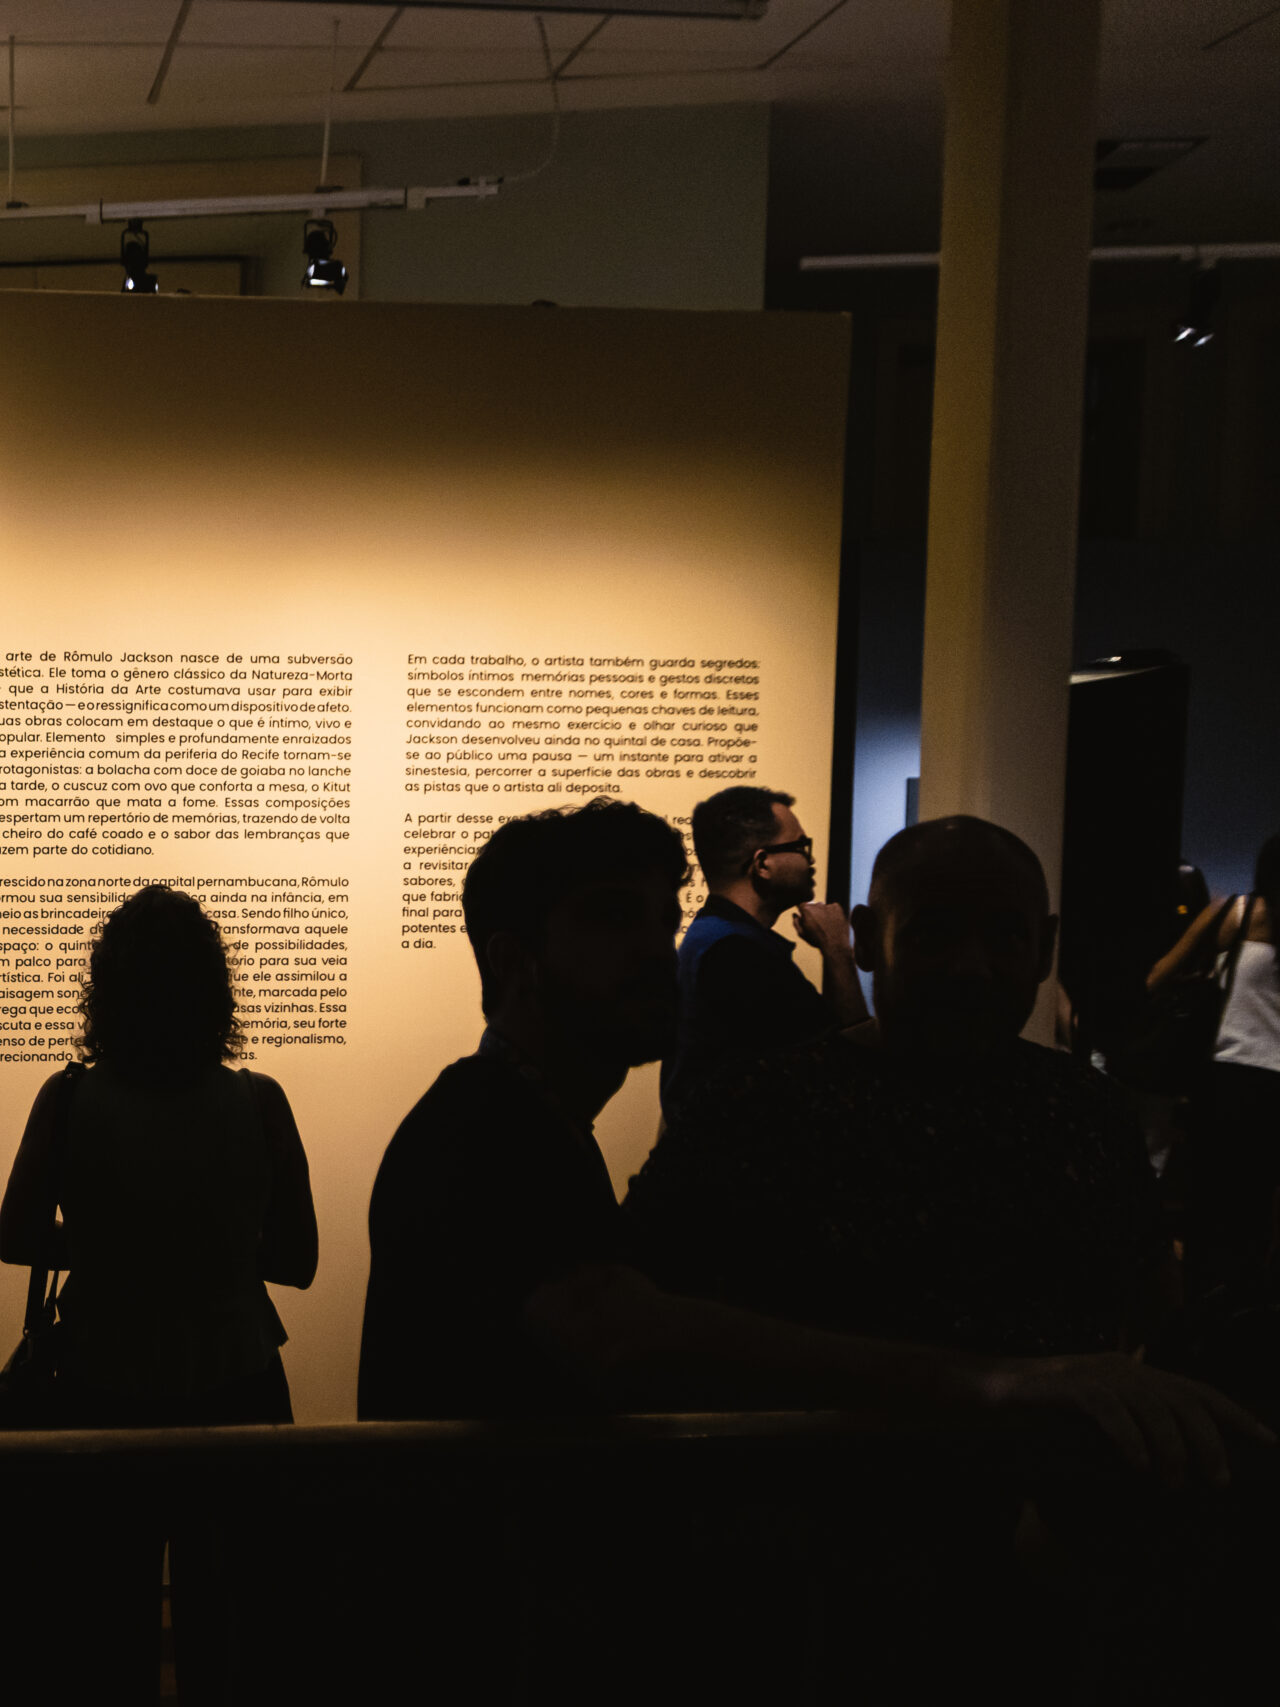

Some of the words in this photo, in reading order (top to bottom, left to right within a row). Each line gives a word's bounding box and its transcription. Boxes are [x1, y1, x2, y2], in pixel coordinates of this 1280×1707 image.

[5, 650, 32, 661] arte
[39, 650, 56, 662] de
[63, 650, 112, 662] Rômulo
[120, 651, 173, 663] Jackson
[180, 654, 219, 663] nasce
[226, 652, 243, 663] de
[250, 655, 279, 664] uma
[287, 653, 353, 665] subversão
[49, 666, 66, 678] Ele
[71, 667, 106, 678] toma
[110, 669, 119, 678] o
[123, 667, 169, 682] gênero
[173, 667, 225, 679] clássico
[229, 668, 246, 679] da
[251, 669, 352, 680] Natureza-Morta
[407, 668, 464, 680] símbolos
[468, 670, 514, 681] íntimos
[521, 671, 585, 682] memórias
[589, 673, 644, 685] pessoais
[647, 674, 655, 683] e
[659, 673, 700, 687] gestos
[703, 673, 759, 685] discretos
[406, 687, 431, 699] que
[437, 688, 451, 696] se
[457, 687, 524, 697] escondem
[530, 688, 562, 698] entre
[568, 689, 613, 700] nomes,
[620, 690, 654, 699] cores
[659, 690, 668, 699] e
[673, 688, 720, 700] formas.
[725, 689, 759, 701] Esses
[24, 715, 62, 726] obras
[65, 715, 123, 727] colocam
[127, 718, 148, 727] em
[152, 716, 213, 730] destaque
[216, 719, 225, 727] o
[228, 719, 253, 731] que
[257, 717, 265, 728] é
[269, 716, 311, 730] íntimo,
[315, 720, 340, 728] vivo
[344, 720, 351, 728] e
[45, 731, 105, 743] Elemento
[115, 731, 165, 746] simples
[168, 734, 176, 743] e
[179, 732, 279, 746] profundamente
[282, 733, 351, 744] enraizados
[406, 733, 457, 744] Jackson
[461, 733, 540, 745] desenvolveu
[544, 735, 580, 745] ainda
[584, 737, 600, 745] no
[603, 736, 647, 749] quintal
[650, 736, 666, 746] de
[670, 737, 704, 747] casa.
[707, 736, 756, 750] Propõe-
[10, 747, 84, 761] experiência
[88, 750, 139, 759] comum
[143, 748, 160, 759] da
[165, 748, 217, 762] periferia
[220, 748, 237, 759] do
[241, 748, 279, 760] Recife
[283, 750, 351, 760] tornam-se
[85, 766, 93, 775] a
[97, 763, 150, 775] bolacha
[153, 766, 182, 775] com
[185, 764, 217, 775] doce
[220, 764, 237, 775] de
[240, 764, 285, 779] goiaba
[289, 767, 305, 776] no
[308, 765, 351, 776] lanche
[25, 796, 90, 807] macarrão
[95, 798, 120, 810] que
[126, 796, 161, 807] mata
[167, 798, 176, 807] a
[182, 795, 217, 807] fome.
[224, 797, 259, 807] Essas
[265, 797, 350, 811] composições
[63, 814, 85, 823] um
[87, 811, 150, 826] repertório
[152, 812, 168, 823] de
[171, 812, 240, 824] memórias,
[242, 812, 298, 824] trazendo
[300, 813, 317, 824] de
[319, 813, 350, 824] volta
[404, 813, 412, 823] A
[418, 813, 451, 826] partir
[456, 813, 493, 823] desse
[403, 828, 456, 839] celebrar
[460, 830, 468, 839] o
[32, 844, 67, 858] parte
[71, 843, 88, 855] do
[91, 843, 154, 855] cotidiano.
[402, 861, 411, 870] a
[419, 860, 470, 872] revisitar
[47, 878, 64, 887] na
[65, 878, 96, 887] zona
[97, 876, 131, 887] norte
[132, 875, 151, 887] da
[196, 876, 299, 890] pernambucana,
[301, 875, 349, 887] Rômulo
[403, 875, 455, 887] sabores,
[401, 893, 426, 905] que
[402, 906, 429, 917] final
[432, 906, 463, 919] para
[401, 923, 456, 936] potentes
[44, 942, 53, 951] o
[254, 938, 347, 953] possibilidades,
[400, 940, 409, 949] a
[412, 937, 436, 949] dia.
[15, 955, 51, 970] palco
[55, 957, 87, 970] para
[259, 957, 289, 969] para
[294, 957, 316, 966] sua
[321, 954, 347, 966] veia
[47, 970, 65, 983] Foi
[252, 970, 271, 982] ele
[275, 970, 335, 981] assimilou
[338, 972, 347, 981] a
[34, 1021, 42, 1030] e
[44, 1021, 74, 1030] essa
[292, 1019, 315, 1028] seu
[317, 1017, 347, 1028] forte
[28, 1035, 45, 1046] de
[250, 1035, 259, 1044] e
[261, 1033, 346, 1047] regionalismo,
